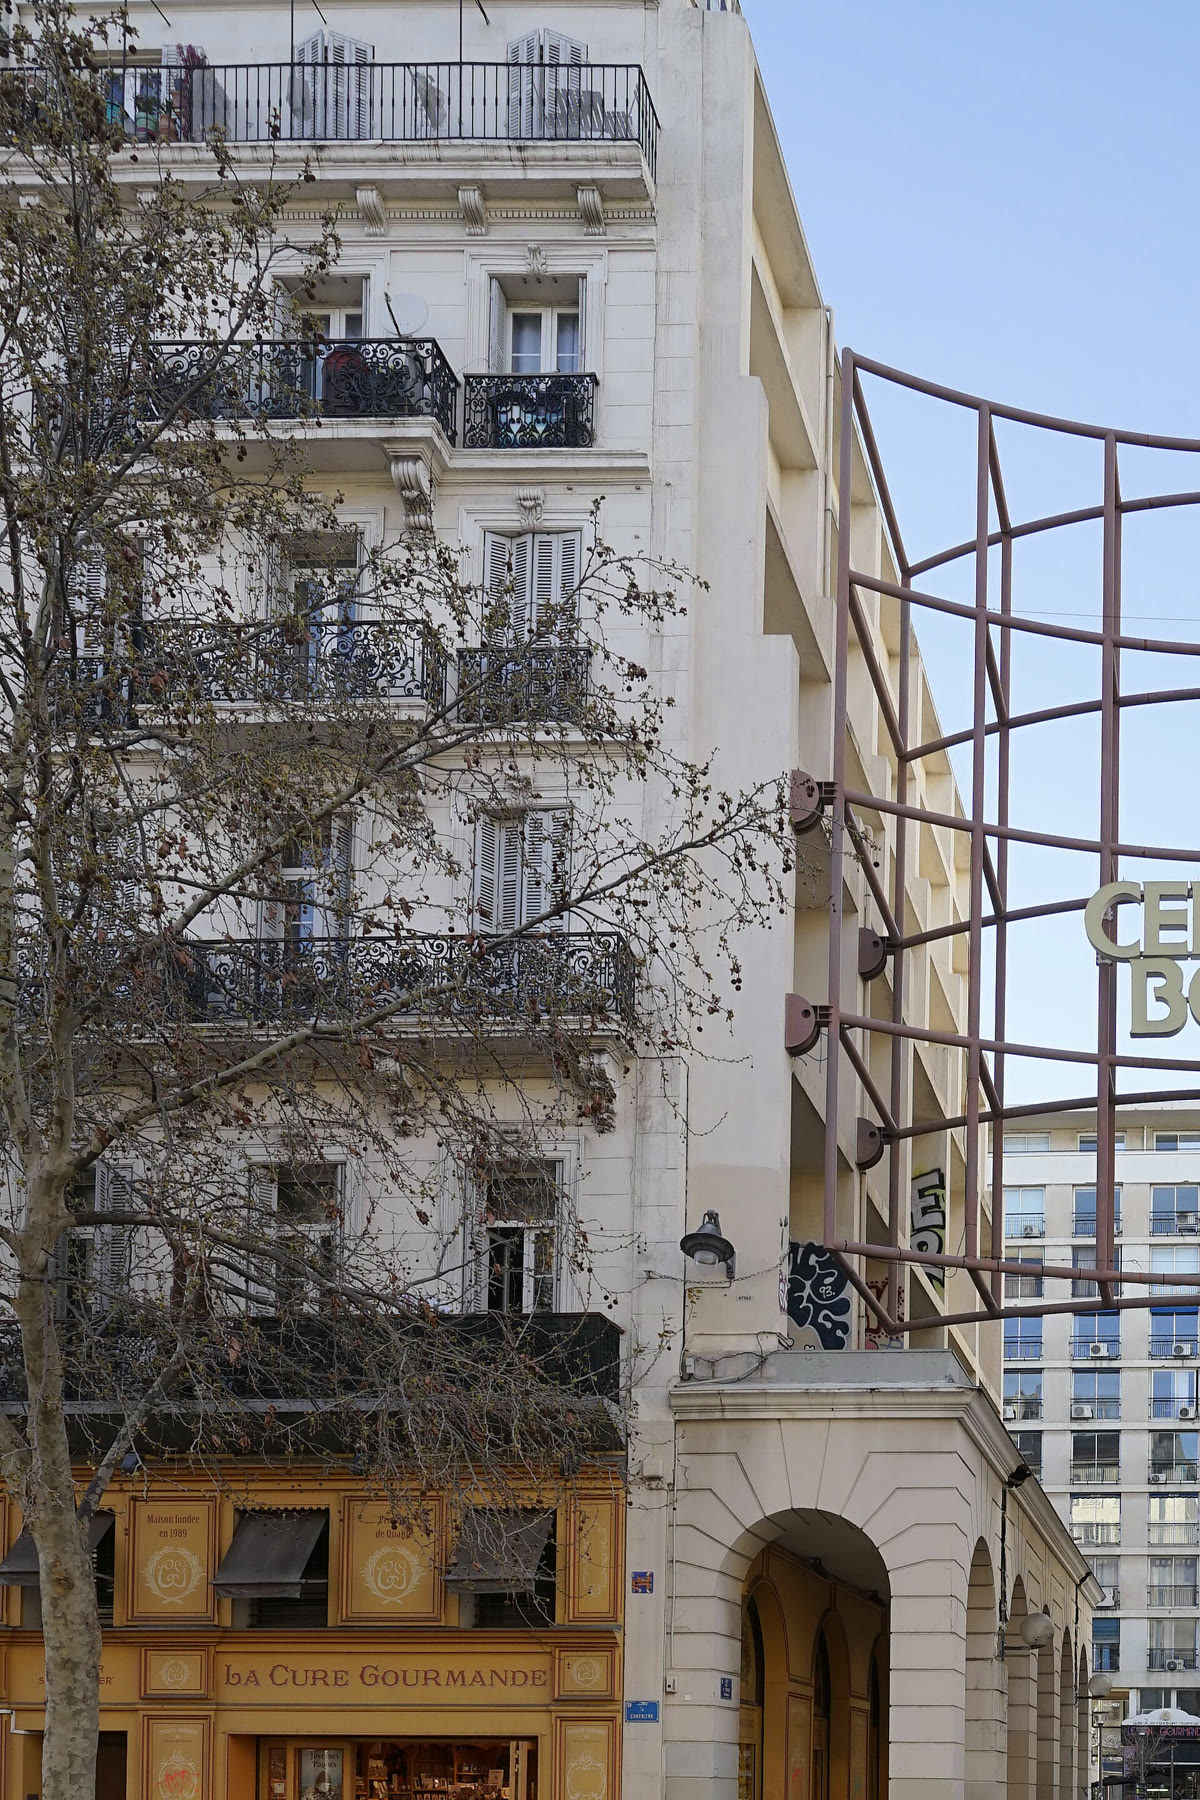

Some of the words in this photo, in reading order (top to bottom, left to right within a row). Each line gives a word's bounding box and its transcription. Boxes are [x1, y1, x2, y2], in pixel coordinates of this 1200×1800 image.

[147, 1515, 173, 1524] Maison
[160, 1530, 168, 1538] en
[170, 1529, 187, 1538] 1989
[225, 1664, 261, 1686] LA
[269, 1664, 349, 1686] CURE
[359, 1664, 547, 1687] GOURMANDE
